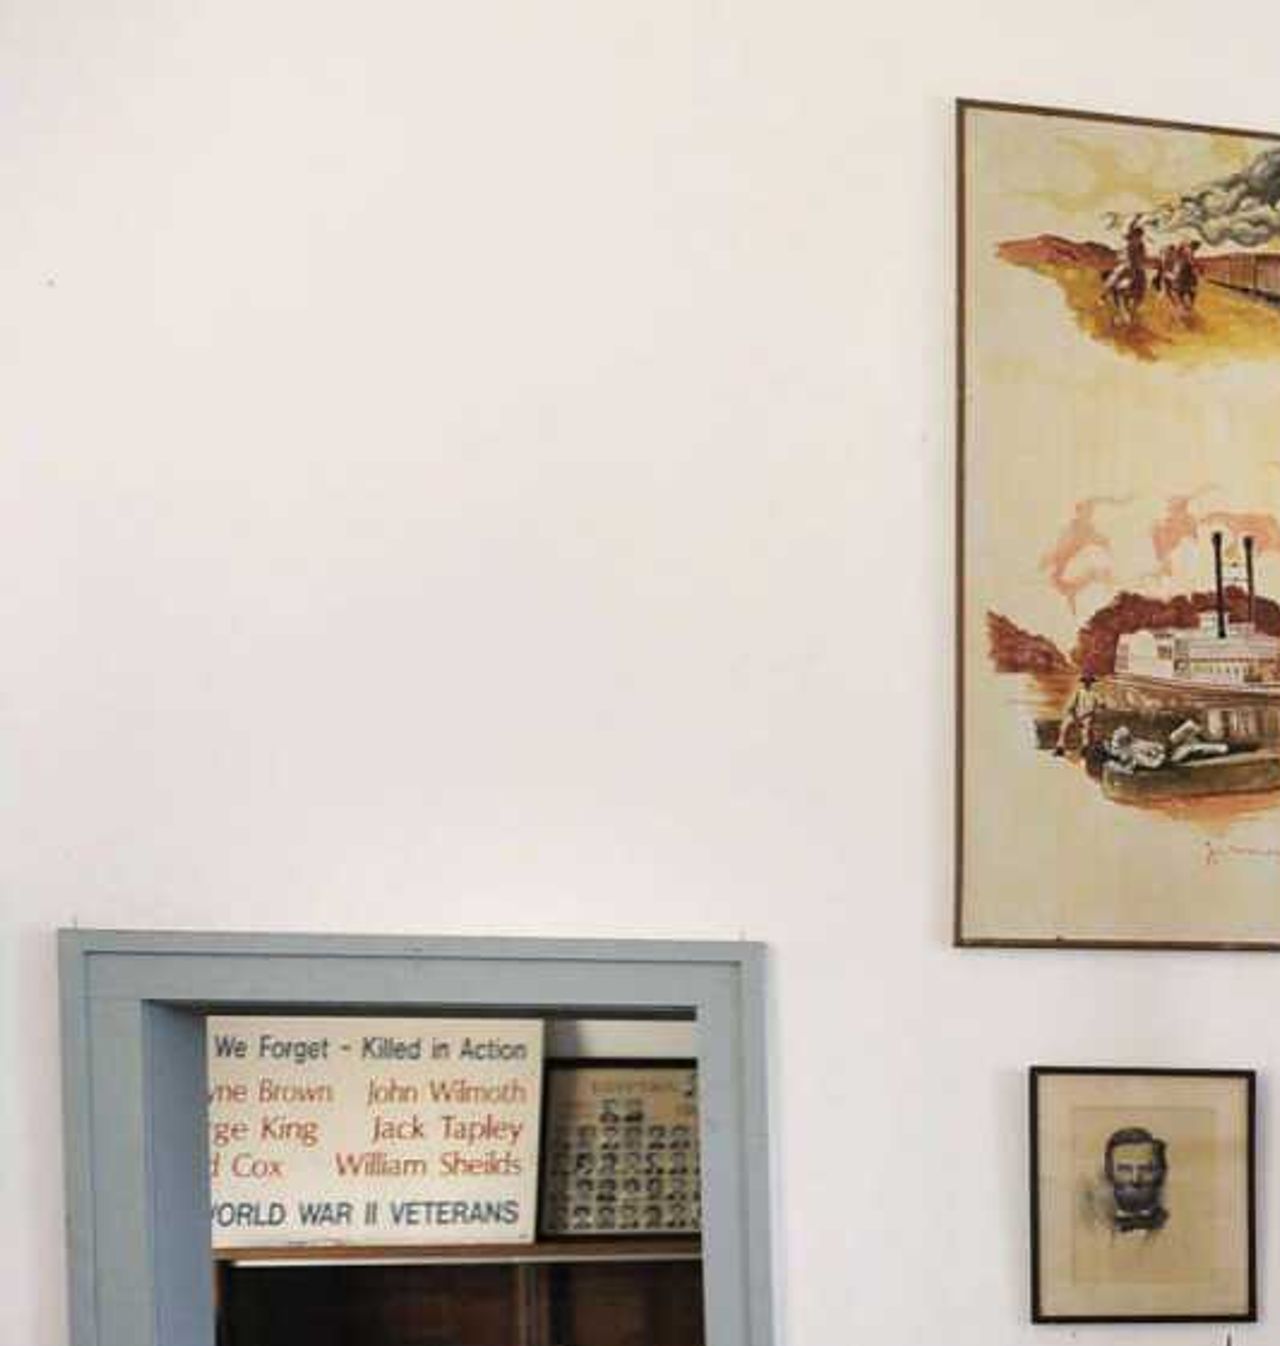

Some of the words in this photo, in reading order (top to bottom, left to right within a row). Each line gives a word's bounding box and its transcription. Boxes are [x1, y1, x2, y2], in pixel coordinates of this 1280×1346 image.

[215, 1034, 248, 1060] We
[259, 1034, 329, 1064] Forget
[361, 1037, 421, 1060] Killed
[431, 1037, 450, 1060] in
[460, 1037, 528, 1061] Action
[259, 1077, 333, 1104] Brown
[367, 1079, 418, 1106] John
[429, 1078, 528, 1103] Wilmoth
[260, 1116, 319, 1148] King
[372, 1115, 424, 1142] Jack
[442, 1115, 523, 1146] Tapley
[231, 1153, 285, 1178] Cox
[334, 1152, 427, 1177] William
[298, 1202, 354, 1226] WAR
[364, 1202, 378, 1225] II
[390, 1199, 520, 1226] VETERANS
